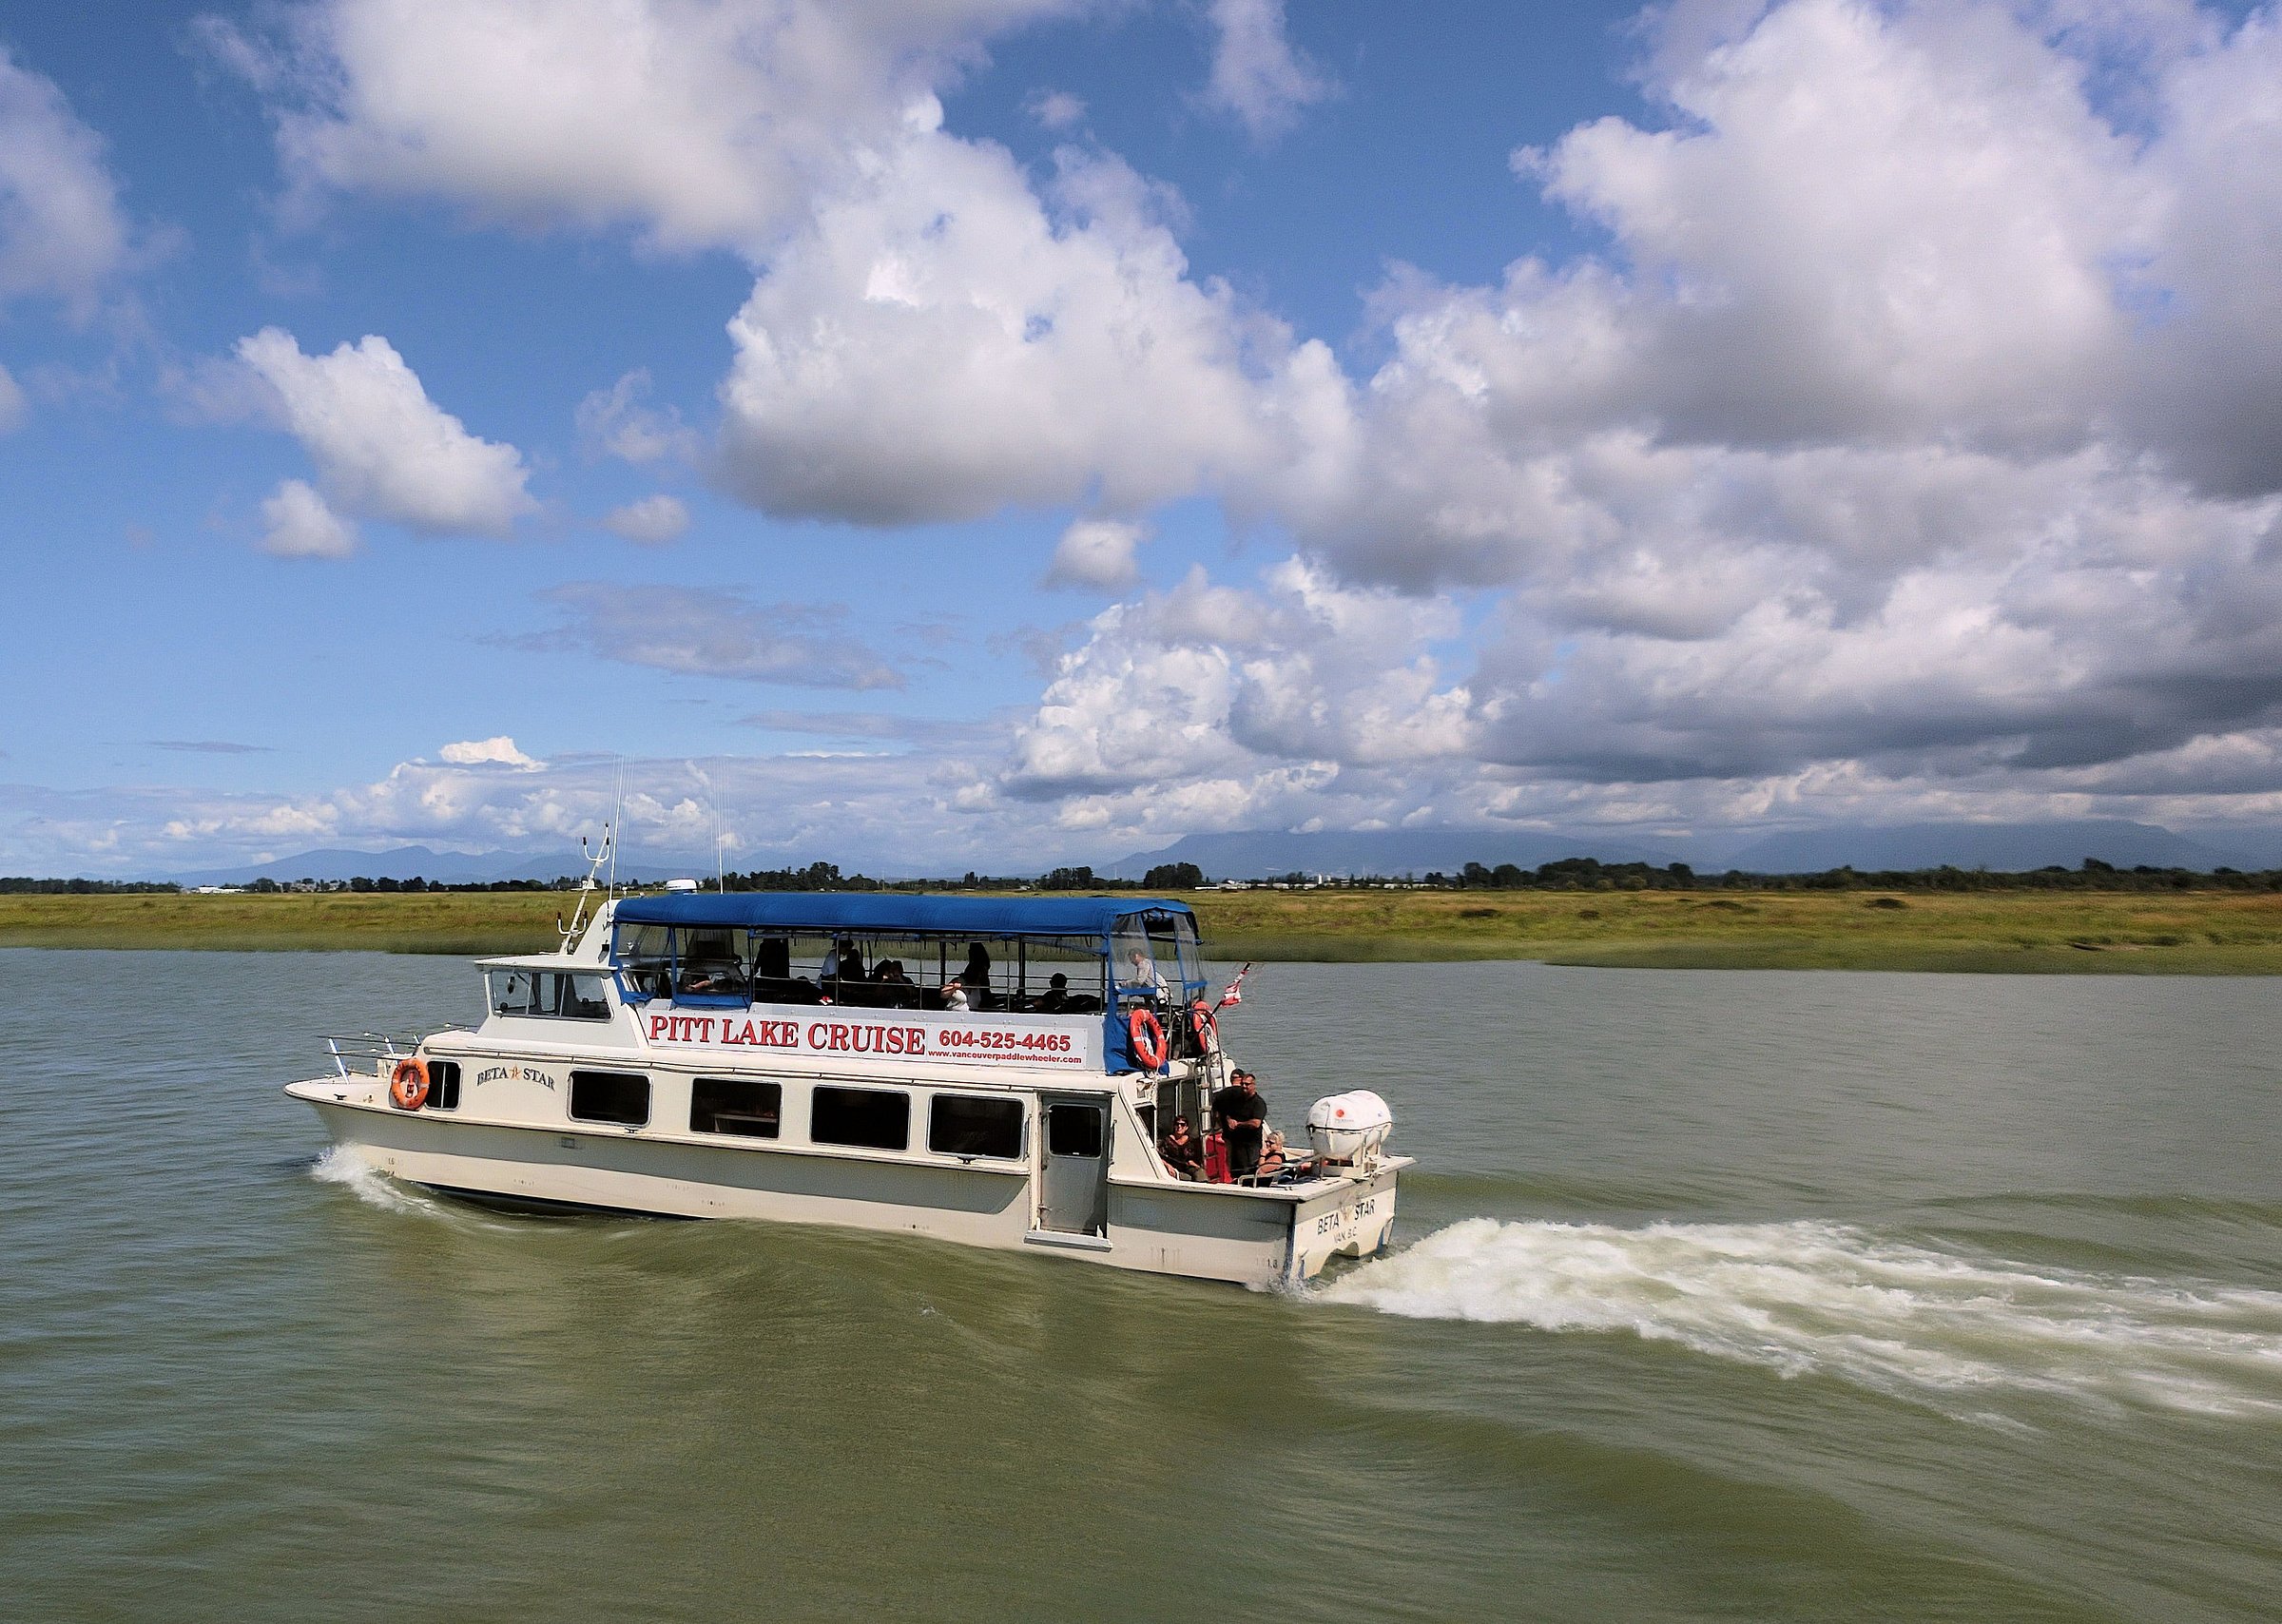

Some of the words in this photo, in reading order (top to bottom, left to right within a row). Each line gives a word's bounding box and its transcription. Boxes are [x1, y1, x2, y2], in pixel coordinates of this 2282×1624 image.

[649, 1015, 714, 1043] PITT
[721, 1018, 799, 1048] LAKE
[807, 1022, 925, 1055] CRUISE
[939, 1030, 1071, 1052] 604-525-4465
[928, 1050, 1082, 1063] www.vancouverpaddlewheeler.com
[476, 1067, 509, 1087] BETA
[523, 1068, 555, 1092] STAR
[1317, 1212, 1340, 1235] BETA
[1354, 1199, 1375, 1220] STAR
